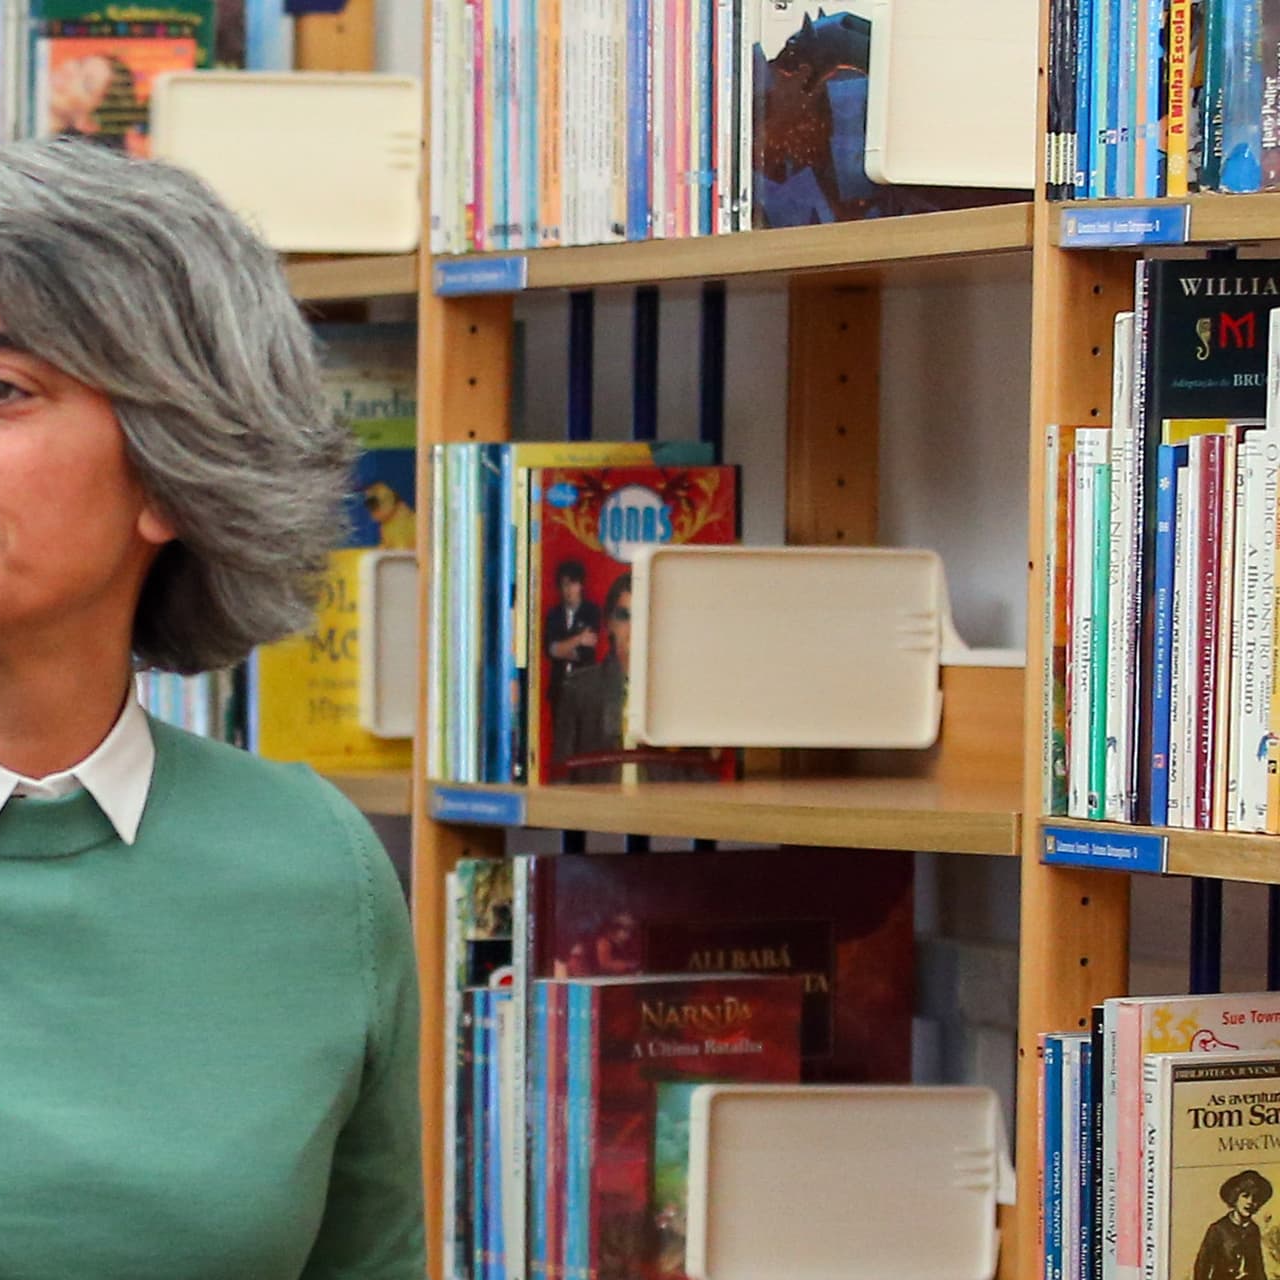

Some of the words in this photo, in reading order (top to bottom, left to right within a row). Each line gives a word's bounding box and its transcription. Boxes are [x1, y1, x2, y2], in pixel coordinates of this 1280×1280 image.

[1170, 9, 1185, 63] Escola
[1171, 69, 1184, 118] Minha
[1171, 124, 1184, 134] A
[1248, 545, 1259, 558] A
[1247, 564, 1259, 603] Ilha
[1246, 607, 1258, 632] do
[1079, 616, 1093, 693] Ivanhoe
[1243, 638, 1257, 716] Tesouro
[1222, 1010, 1246, 1026] Sue
[1206, 1093, 1227, 1107] As
[1081, 1102, 1090, 1128] Kate
[1187, 1107, 1243, 1131] Tom
[1217, 1135, 1259, 1154] MARK
[1145, 1148, 1157, 1230] aventuras
[1145, 1235, 1156, 1260] de
